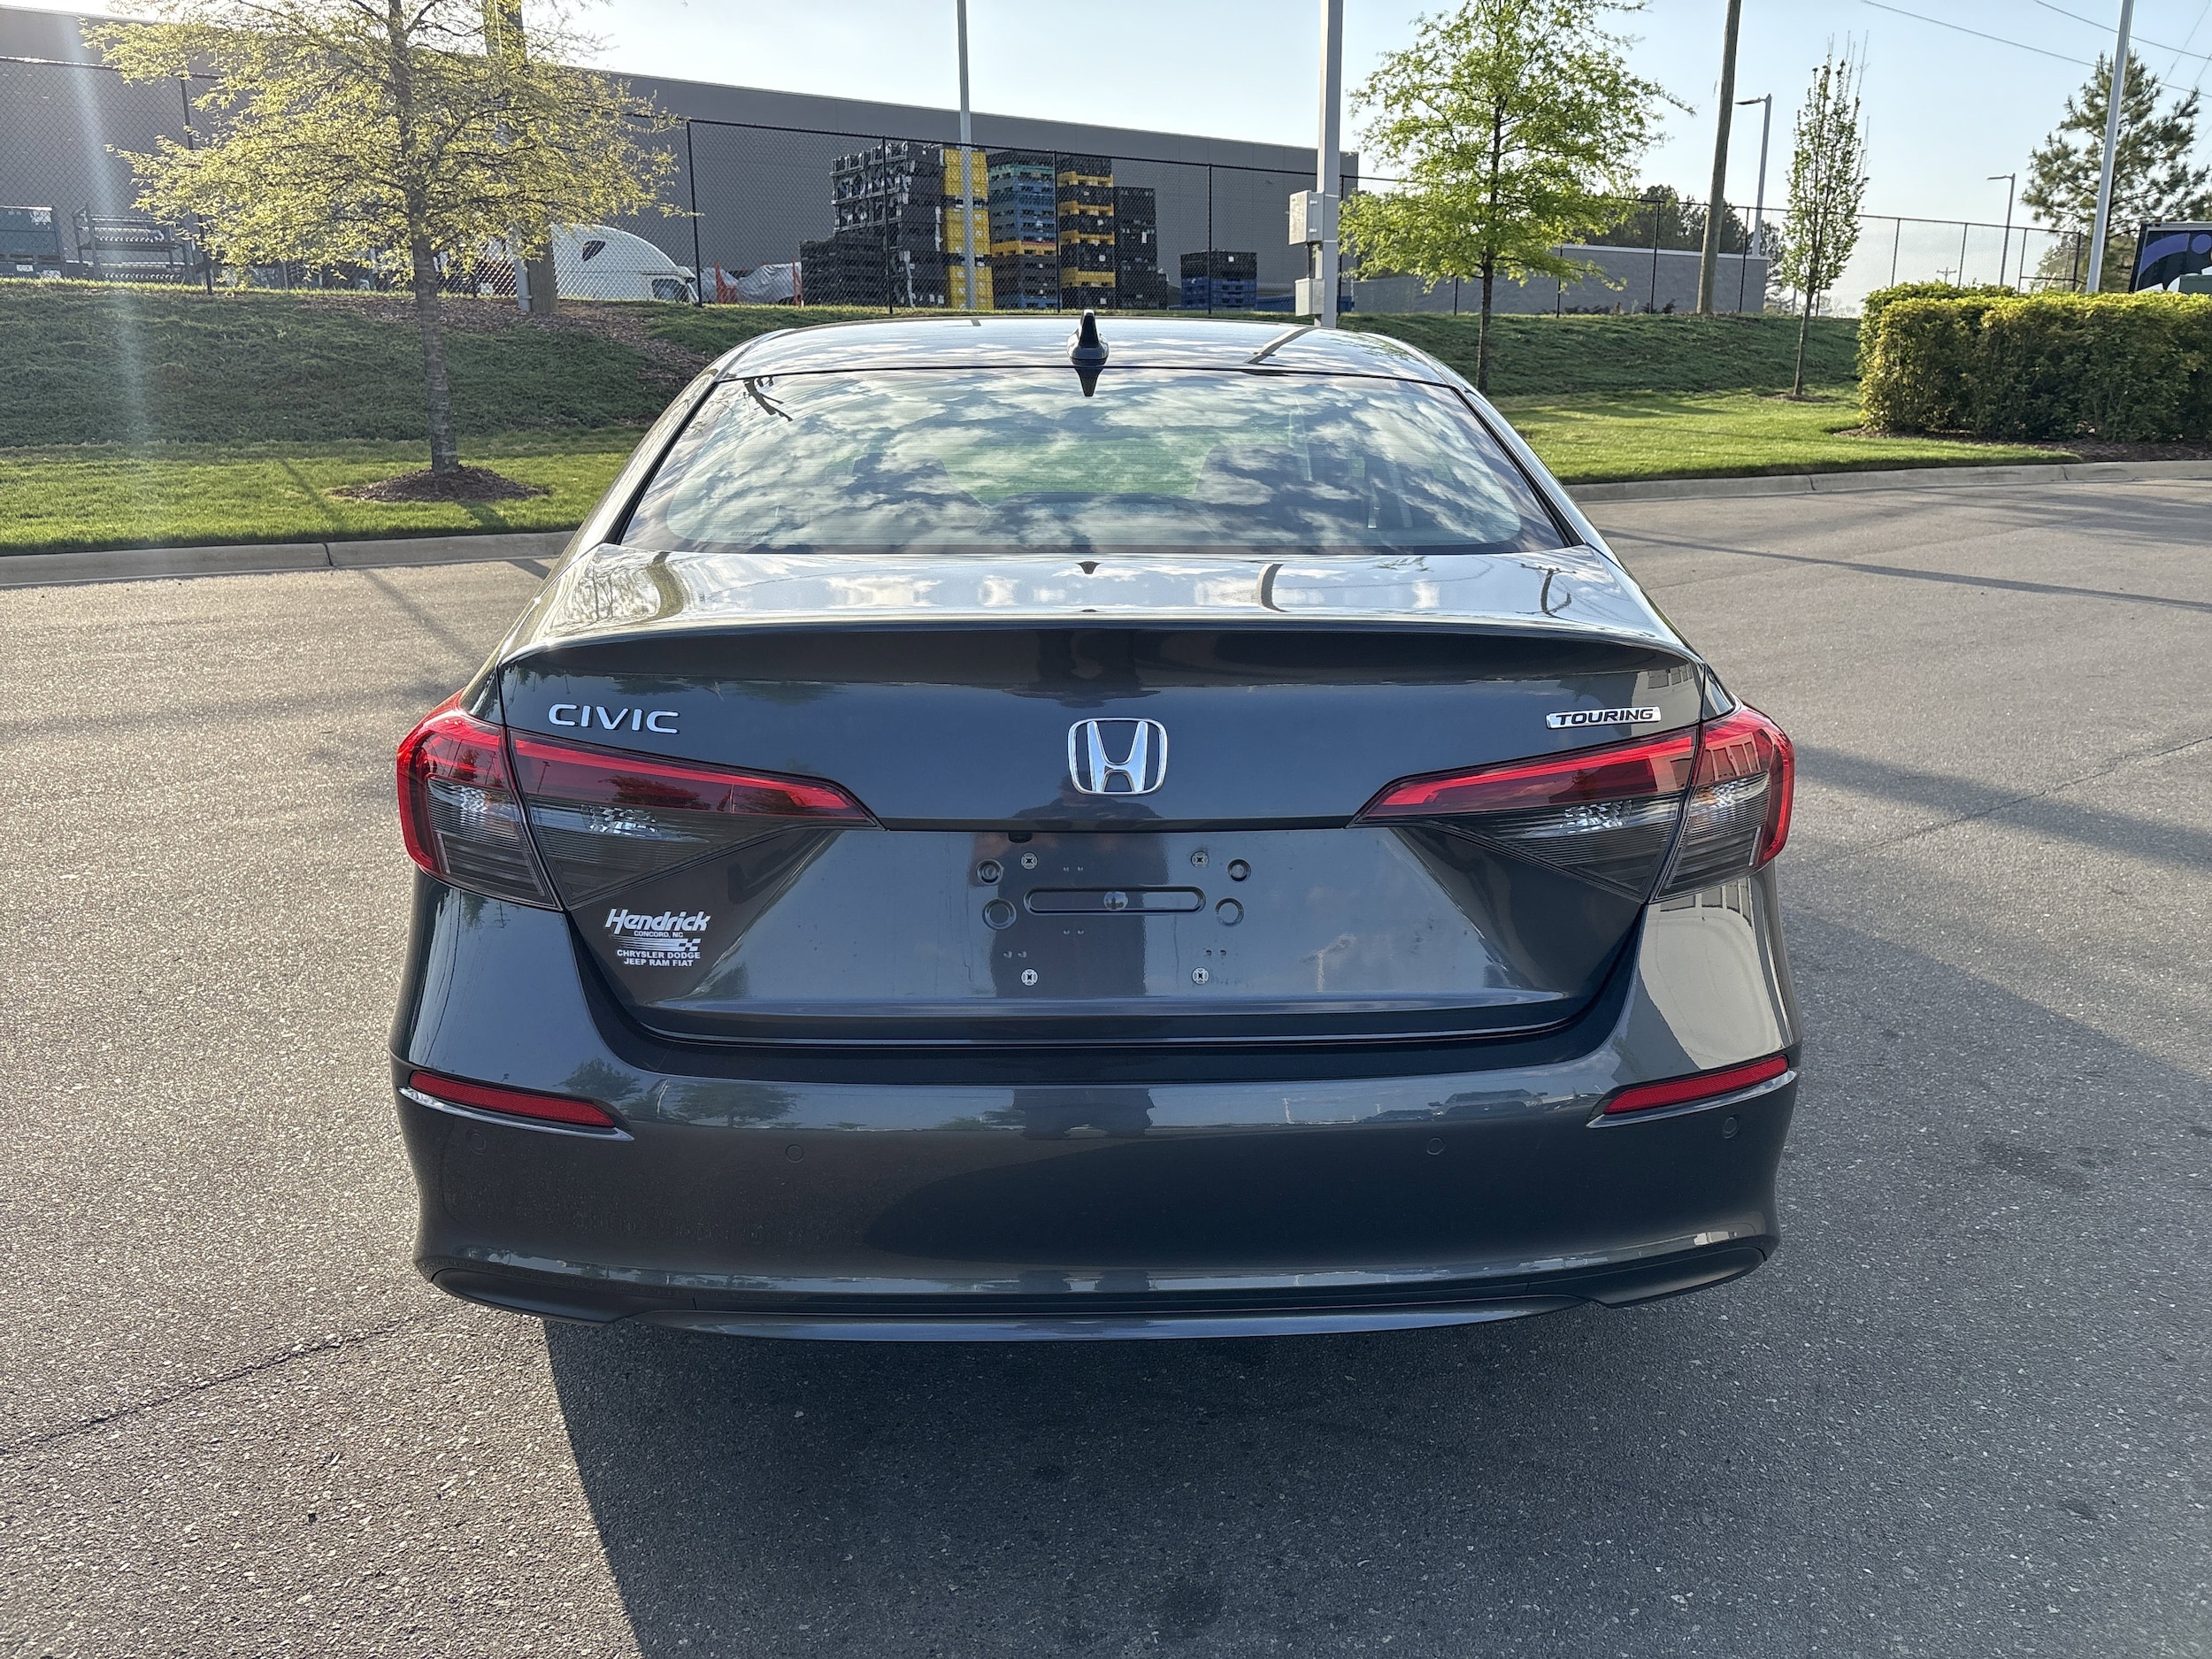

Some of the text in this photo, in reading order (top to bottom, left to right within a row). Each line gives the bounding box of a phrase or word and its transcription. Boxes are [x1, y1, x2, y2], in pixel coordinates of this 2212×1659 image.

[548, 703, 680, 733] CIVIC
[1555, 709, 1653, 725] TOURING
[604, 908, 711, 934] Hendrick
[617, 949, 664, 958] CHRYSLER
